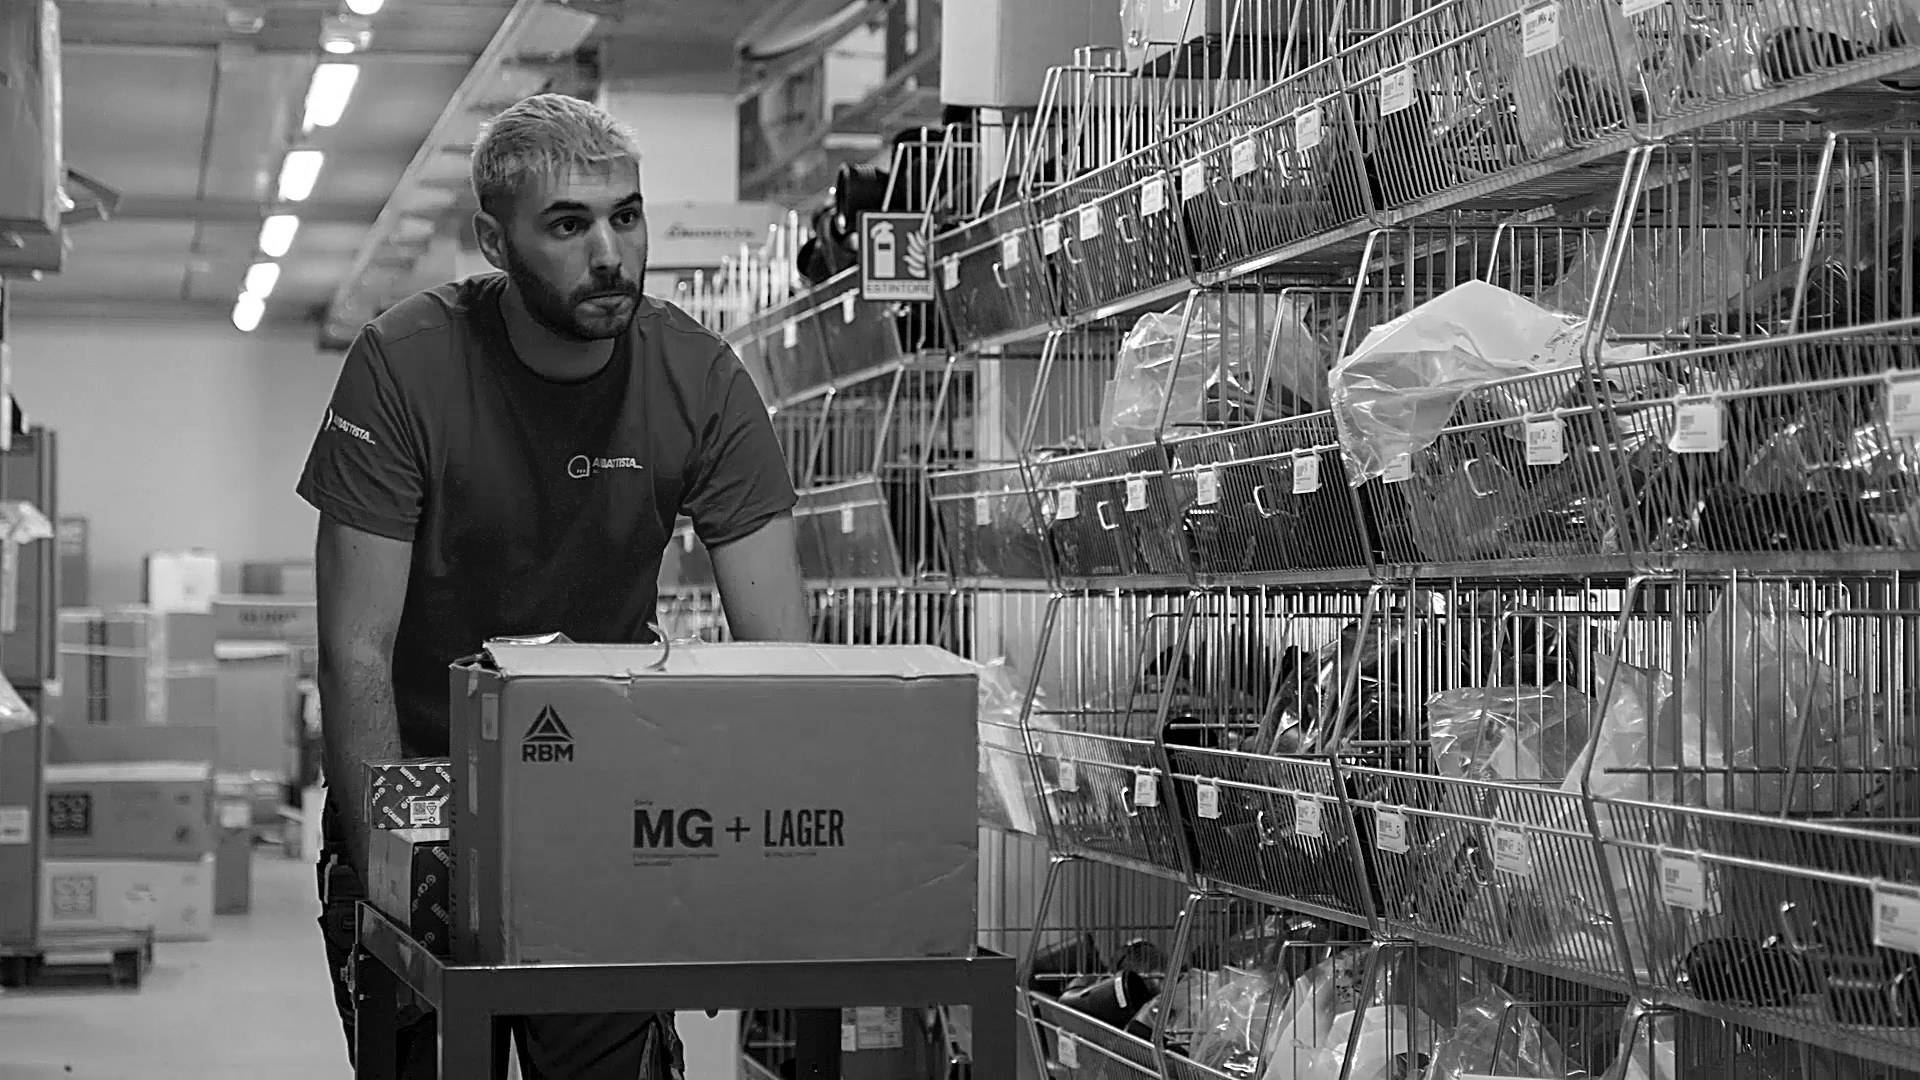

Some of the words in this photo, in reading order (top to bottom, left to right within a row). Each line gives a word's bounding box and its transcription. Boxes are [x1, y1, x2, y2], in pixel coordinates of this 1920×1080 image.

[866, 284, 930, 296] ESTINTORE
[522, 743, 574, 763] RBM
[633, 808, 713, 849] MG
[725, 816, 751, 842] +
[764, 808, 844, 848] LAGER
